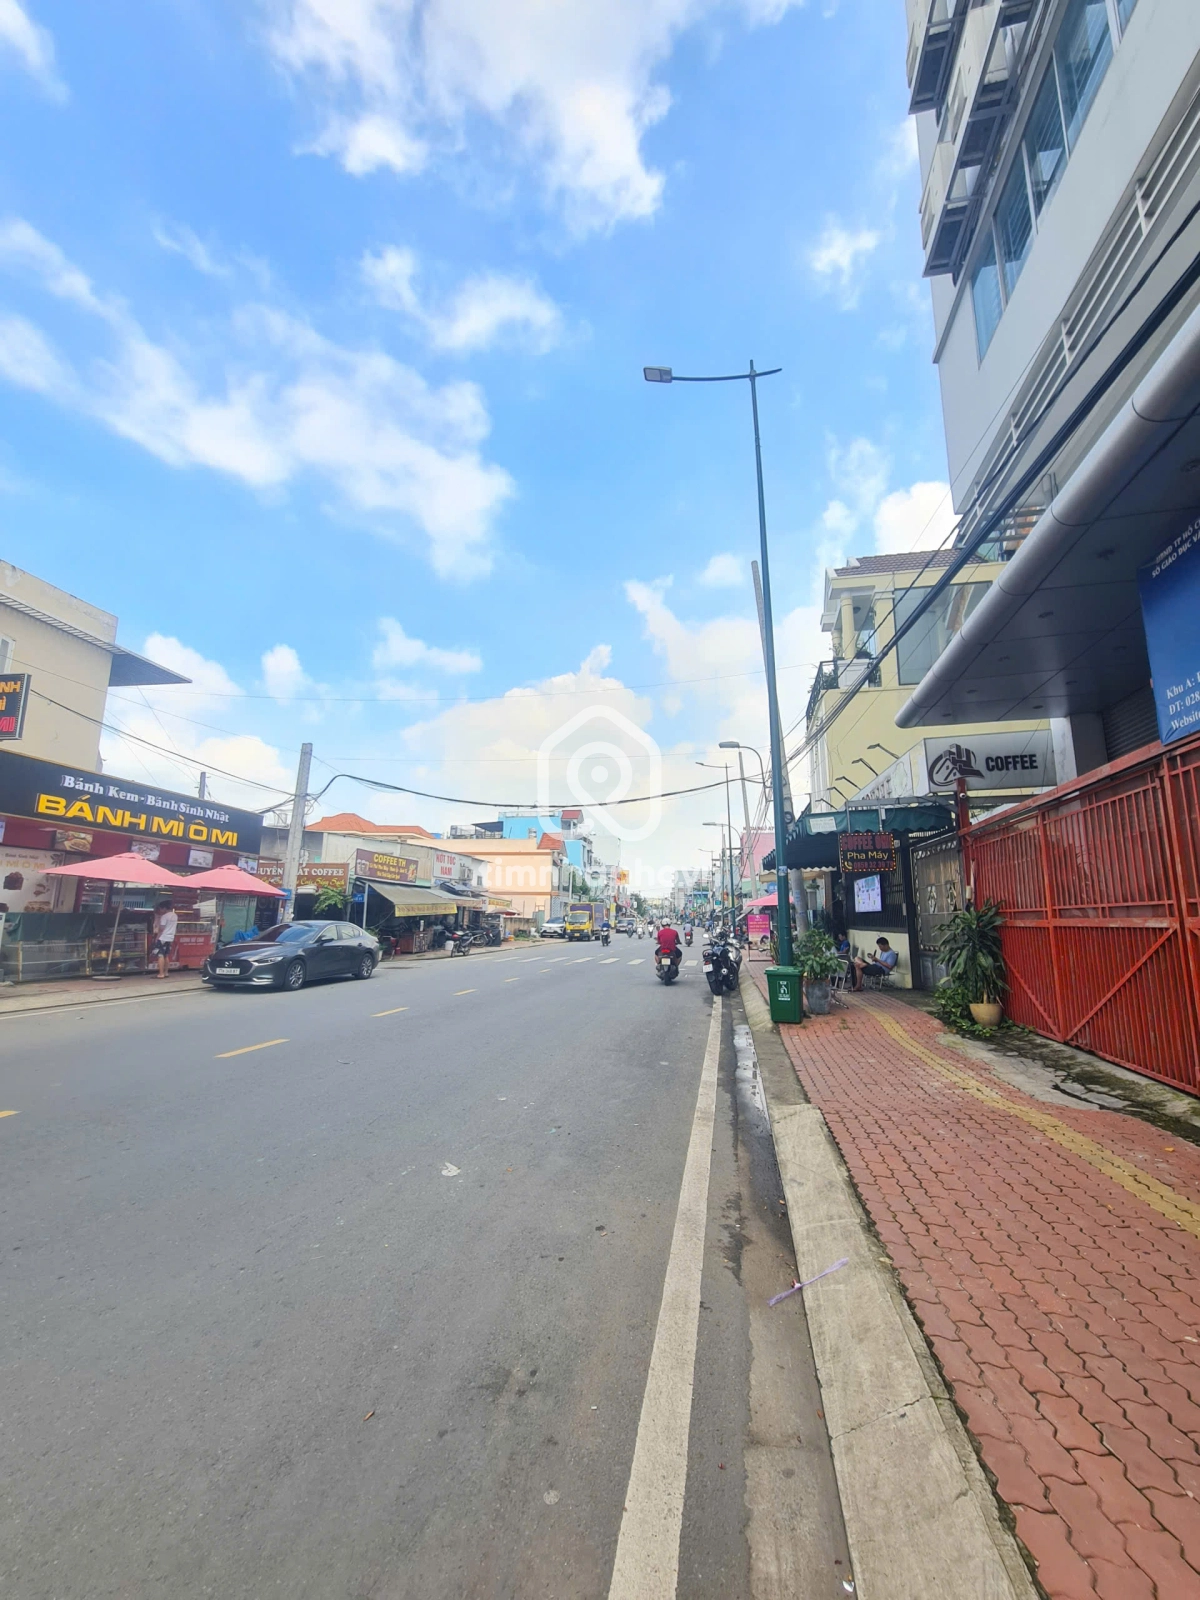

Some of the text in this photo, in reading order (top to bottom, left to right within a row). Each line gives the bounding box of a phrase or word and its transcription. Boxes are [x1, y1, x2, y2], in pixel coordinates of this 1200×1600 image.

[1166, 684, 1184, 700] Khu
[985, 754, 1038, 772] COFFEE
[61, 774, 104, 795] Bánh
[106, 785, 139, 803] Kem
[145, 794, 178, 812] Bánh
[178, 802, 204, 817] Sinh
[204, 808, 230, 824] Nhật
[36, 793, 238, 847] BÁNH MÌ Ô MI
[373, 853, 398, 866] COFFEE
[847, 850, 889, 861] Pha Máy
[311, 867, 345, 876] COFFEE
